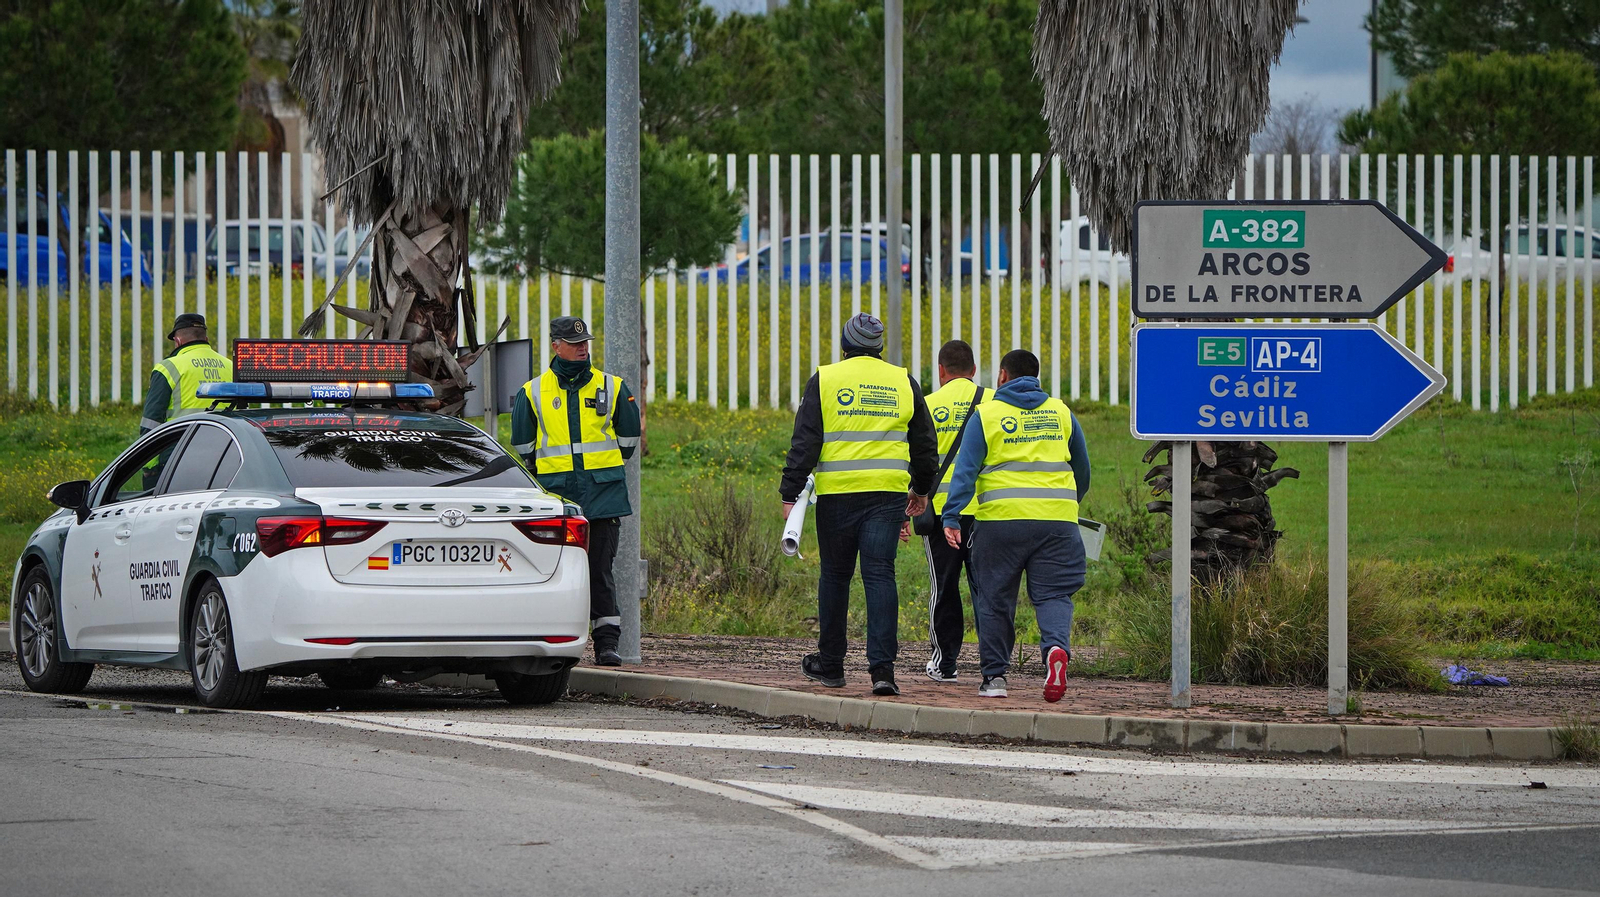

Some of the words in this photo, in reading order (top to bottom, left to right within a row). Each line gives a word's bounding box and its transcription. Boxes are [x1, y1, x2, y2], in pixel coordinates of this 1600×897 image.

[1208, 219, 1299, 243] A-382
[1198, 252, 1311, 276] ARCOS
[1145, 285, 1176, 303] DE
[1188, 285, 1219, 303] LA
[1231, 285, 1363, 303] FRONTERA
[237, 343, 407, 370] PRECAUCION
[1203, 342, 1241, 361] E-5
[1256, 341, 1318, 368] AP-4
[191, 358, 226, 369] GUARDIA
[203, 368, 221, 380] CIVIL
[312, 390, 350, 398] TRAFICO
[859, 384, 898, 393] PLATAFORMA
[1209, 374, 1297, 398] Cádiz
[837, 407, 900, 418] www.plataformanacional.es
[1197, 404, 1310, 428] Sevilla
[350, 435, 423, 443] TRAFICO
[399, 430, 442, 438] CIVIL
[1003, 433, 1064, 445] www.plataformanacional.es
[239, 532, 257, 553] 062
[402, 545, 435, 562] PGC
[129, 562, 161, 580] GUARDIA
[161, 560, 180, 577] CIVIL
[140, 582, 172, 601] TRAFICO
